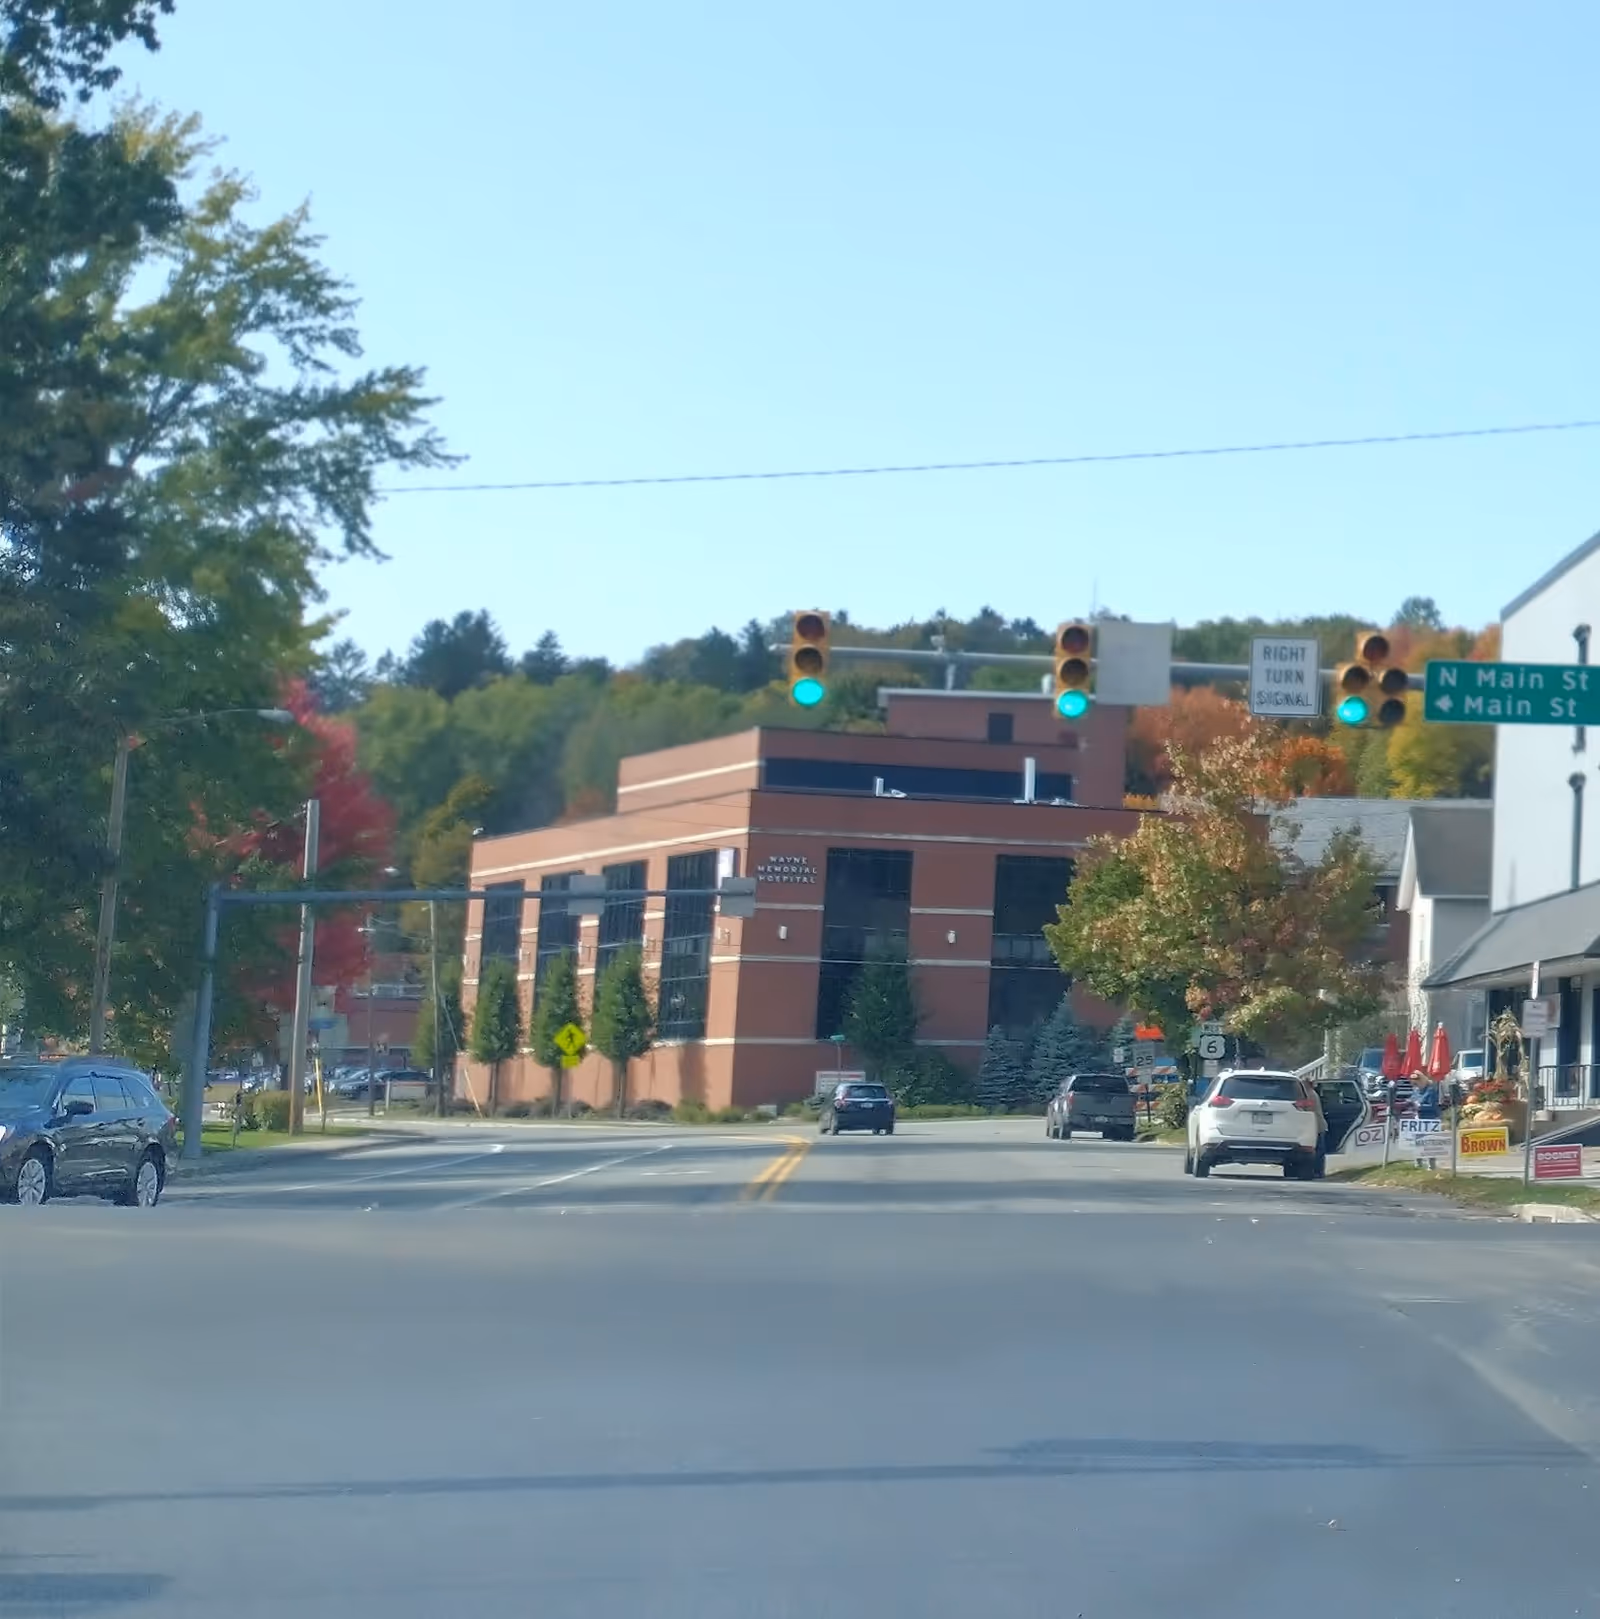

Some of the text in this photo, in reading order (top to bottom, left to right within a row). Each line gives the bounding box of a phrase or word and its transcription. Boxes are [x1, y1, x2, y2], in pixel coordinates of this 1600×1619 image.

[1263, 646, 1306, 662] RIGHT
[1265, 668, 1305, 685] TURN
[1439, 667, 1589, 691] N Main St
[1256, 690, 1313, 707] SIGNAL
[1463, 694, 1577, 718] Main St
[769, 856, 808, 864] WAYNE
[757, 865, 818, 875] MEMORIAL
[759, 875, 816, 884] HOSPITAL
[1207, 1040, 1218, 1054] 6
[1136, 1055, 1153, 1067] 25
[1401, 1120, 1440, 1133] FRITZ
[1358, 1129, 1382, 1143] OZ
